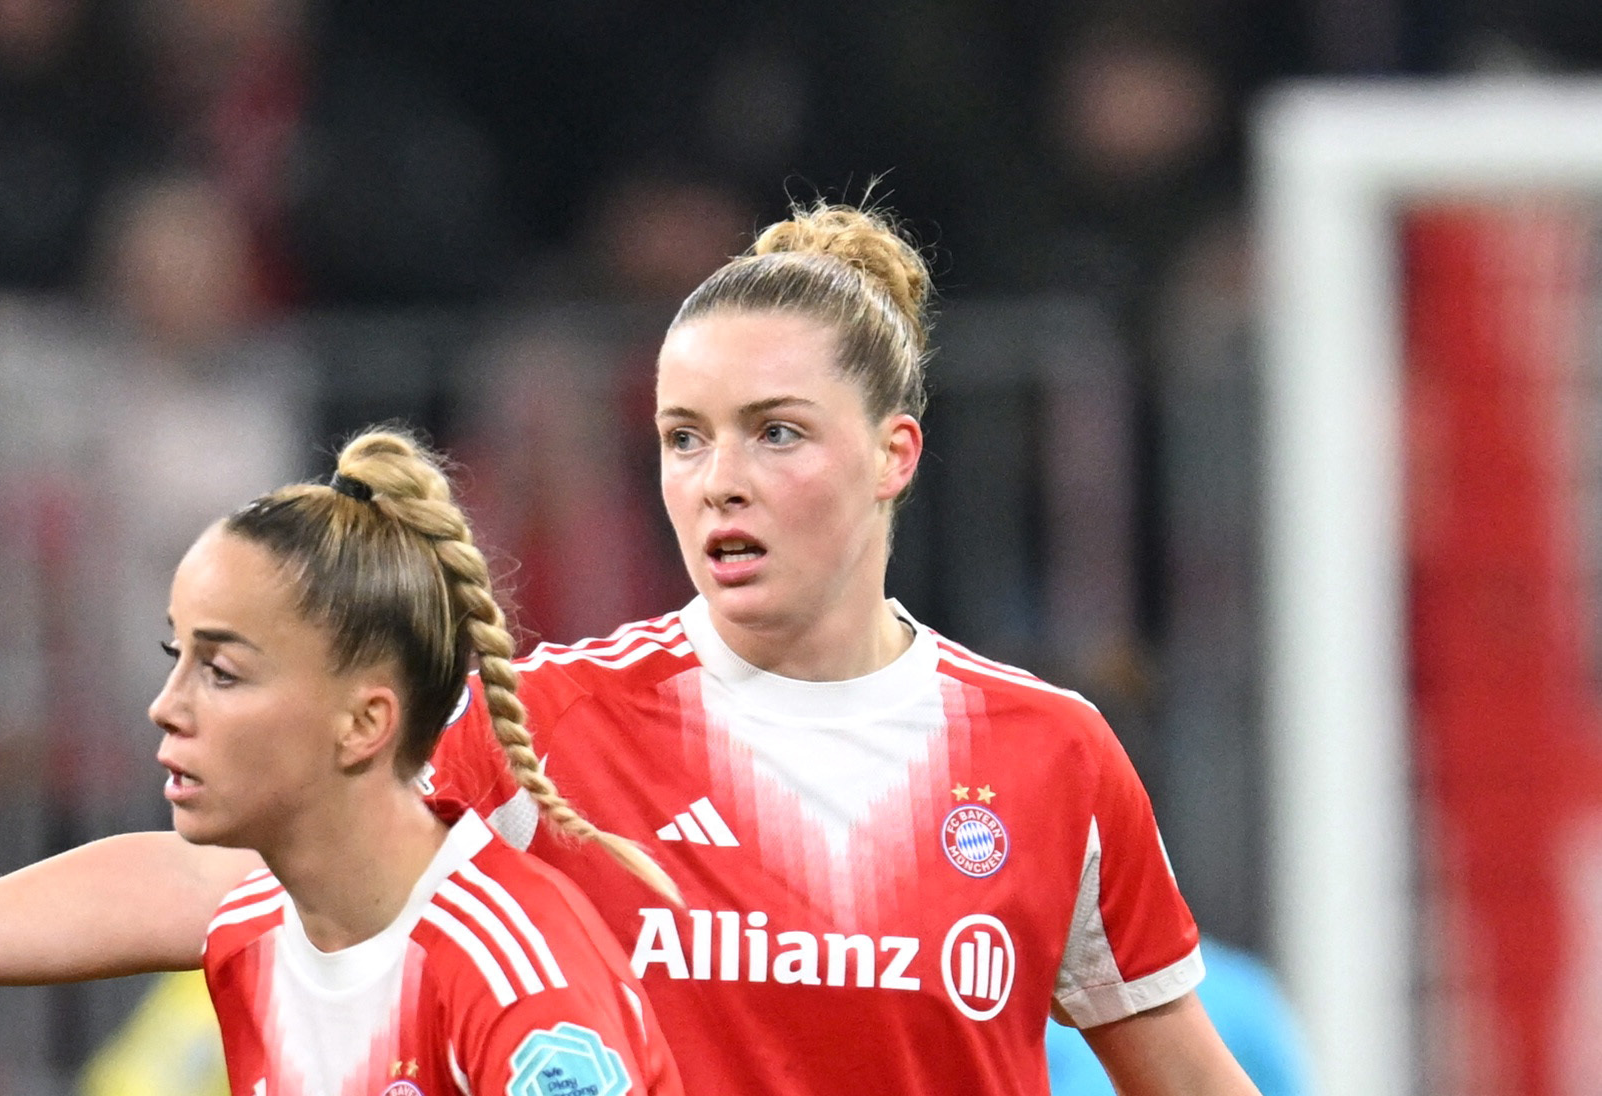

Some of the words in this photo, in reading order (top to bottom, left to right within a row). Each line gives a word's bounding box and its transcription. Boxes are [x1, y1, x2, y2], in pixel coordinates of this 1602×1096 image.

[947, 817, 960, 834] FC
[959, 809, 1003, 839] BAYERN
[630, 907, 920, 991] Allianz
